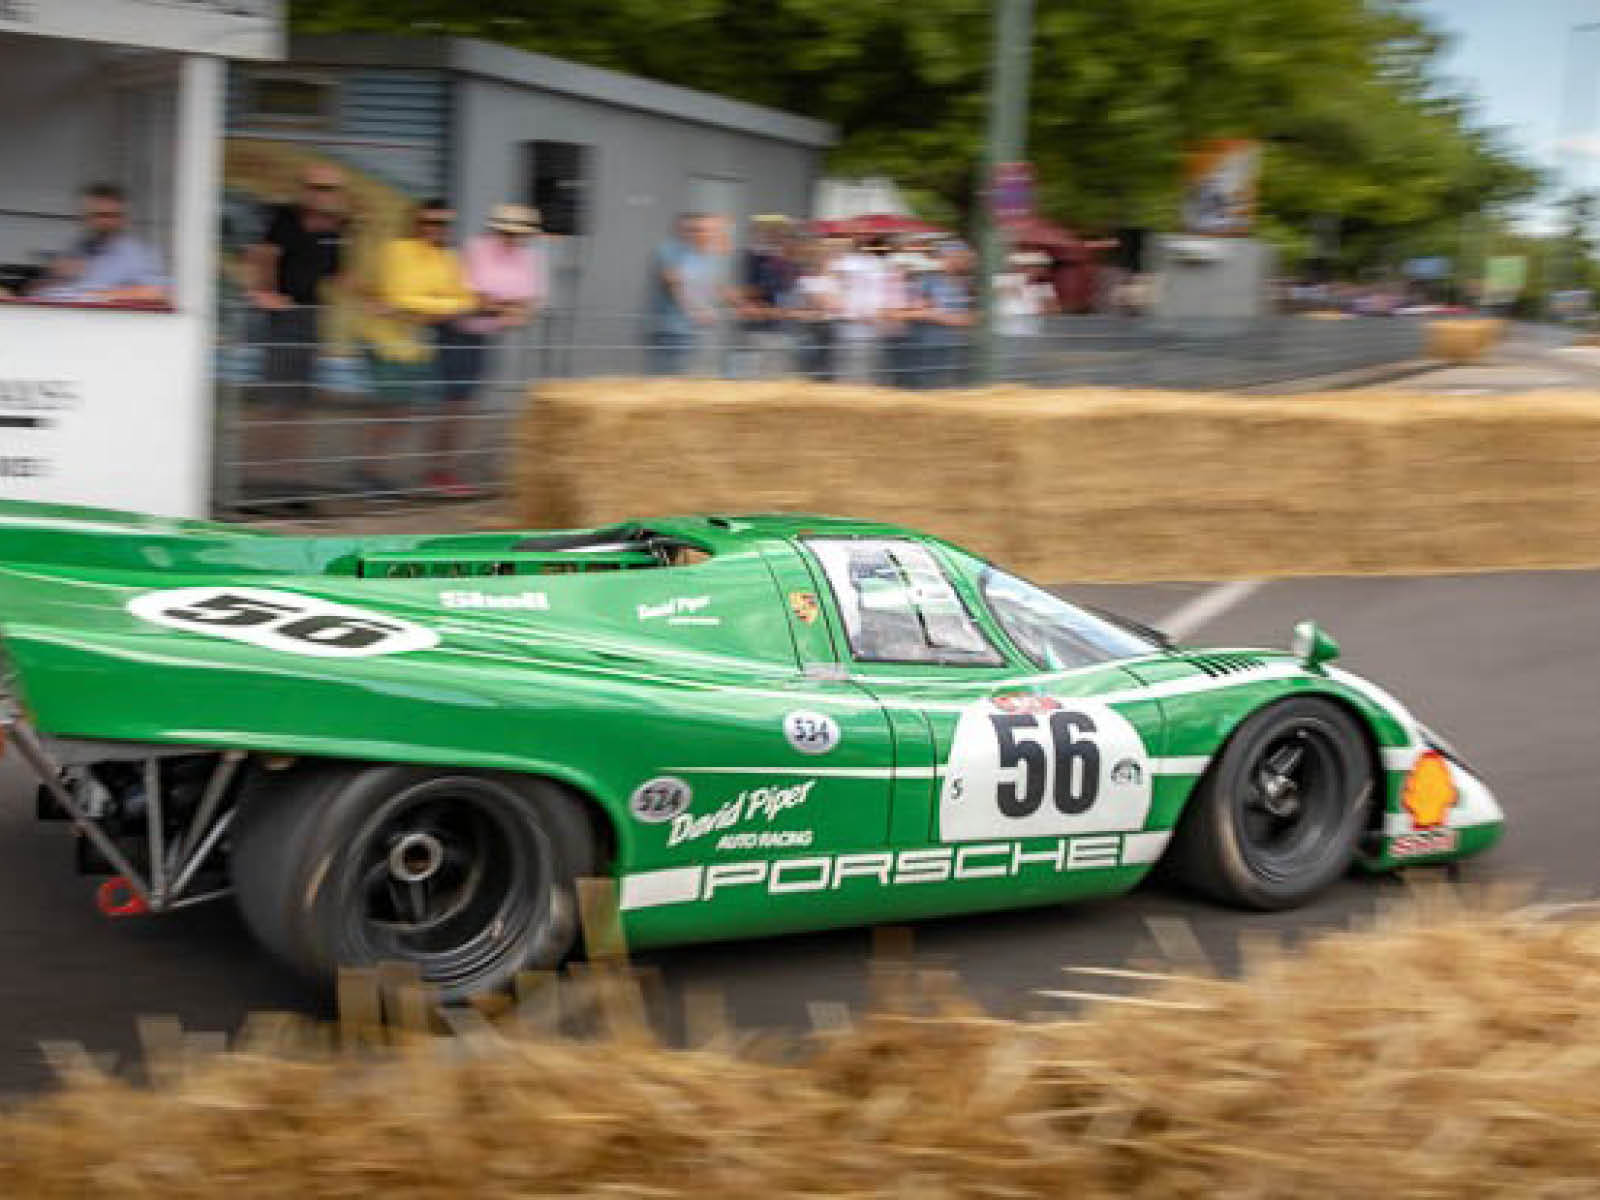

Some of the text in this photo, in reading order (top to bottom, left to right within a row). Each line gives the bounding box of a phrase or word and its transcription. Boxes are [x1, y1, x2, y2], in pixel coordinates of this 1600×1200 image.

[161, 593, 404, 648] 56
[990, 711, 1099, 818] 56
[666, 778, 816, 848] David Piper
[702, 835, 1121, 901] PORSCHE
